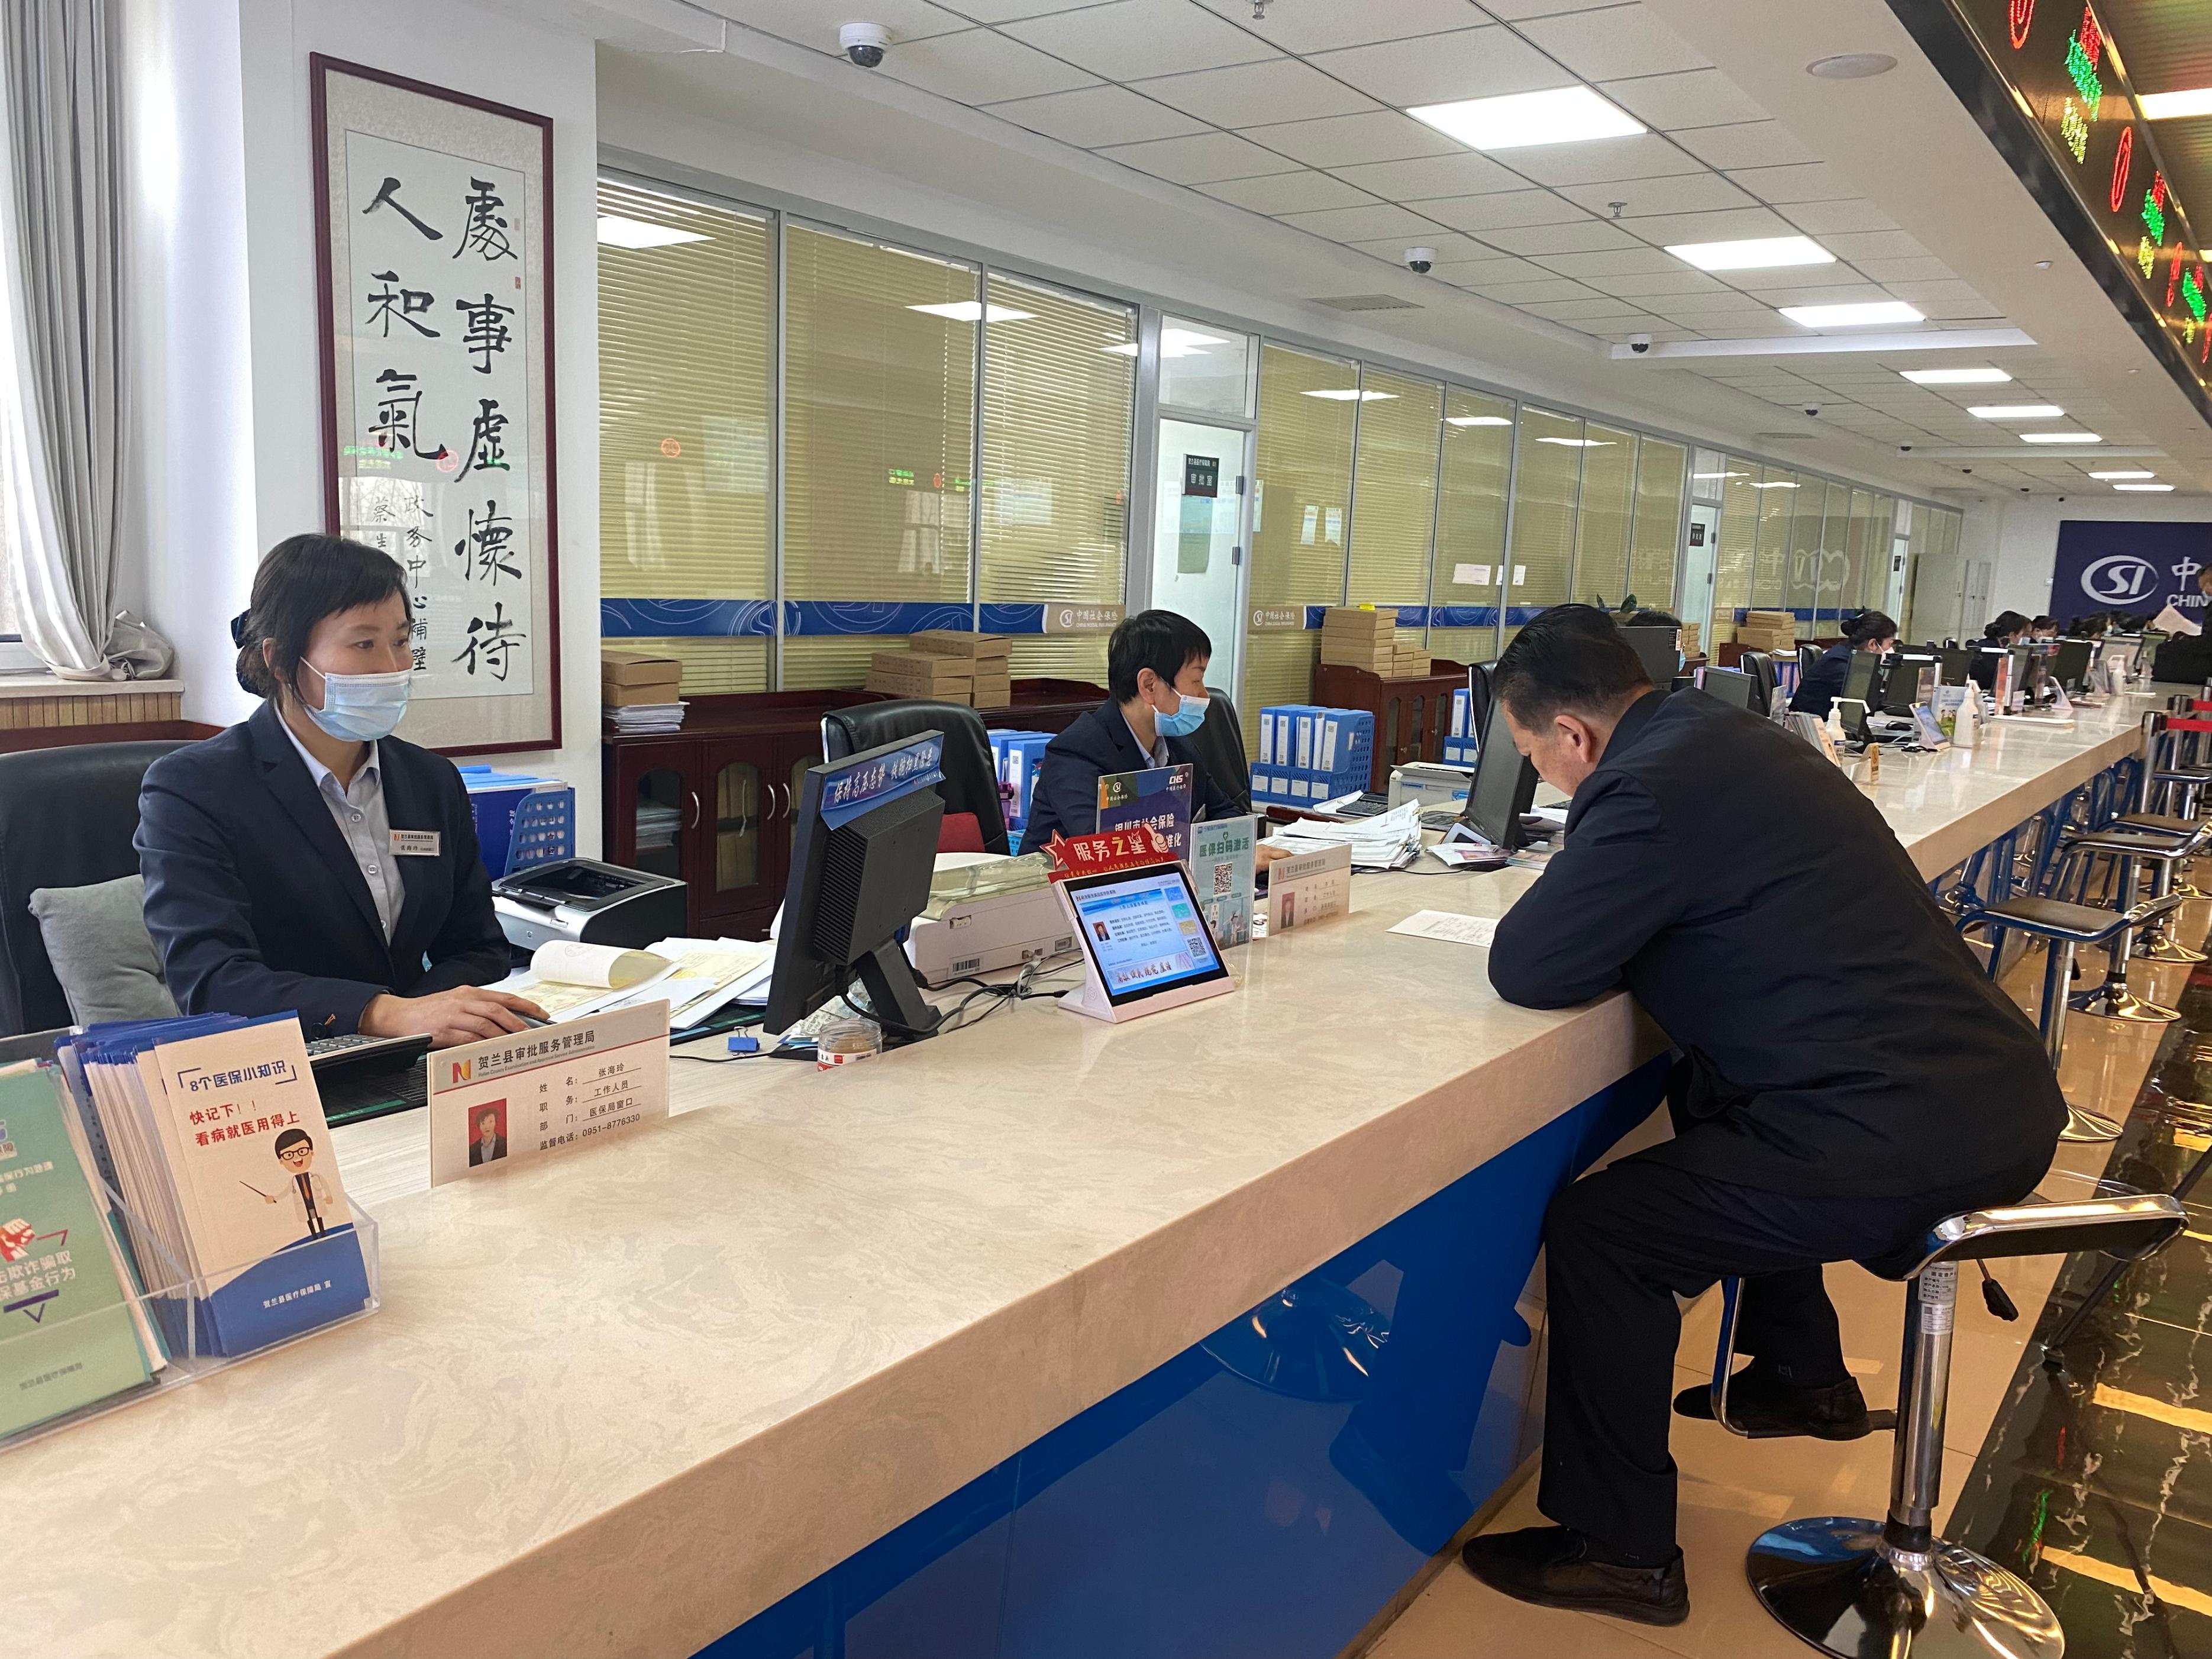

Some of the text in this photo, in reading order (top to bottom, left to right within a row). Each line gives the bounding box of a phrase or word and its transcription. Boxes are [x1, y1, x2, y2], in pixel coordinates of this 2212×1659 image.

[2172, 556, 2202, 591] 中
[1073, 831, 1147, 862] 服务之星
[1200, 837, 1249, 857] 医保扫码激活
[478, 1030, 595, 1070] 贺兰县审批服务管理局
[190, 1060, 286, 1092] 8个医保小知识
[599, 1063, 624, 1077] 张海玲
[594, 1080, 628, 1097] 工作人员
[589, 1098, 632, 1117] 医保局窗口
[195, 1111, 300, 1147] 看病就医用得上
[582, 1113, 640, 1137] 0951-8776330
